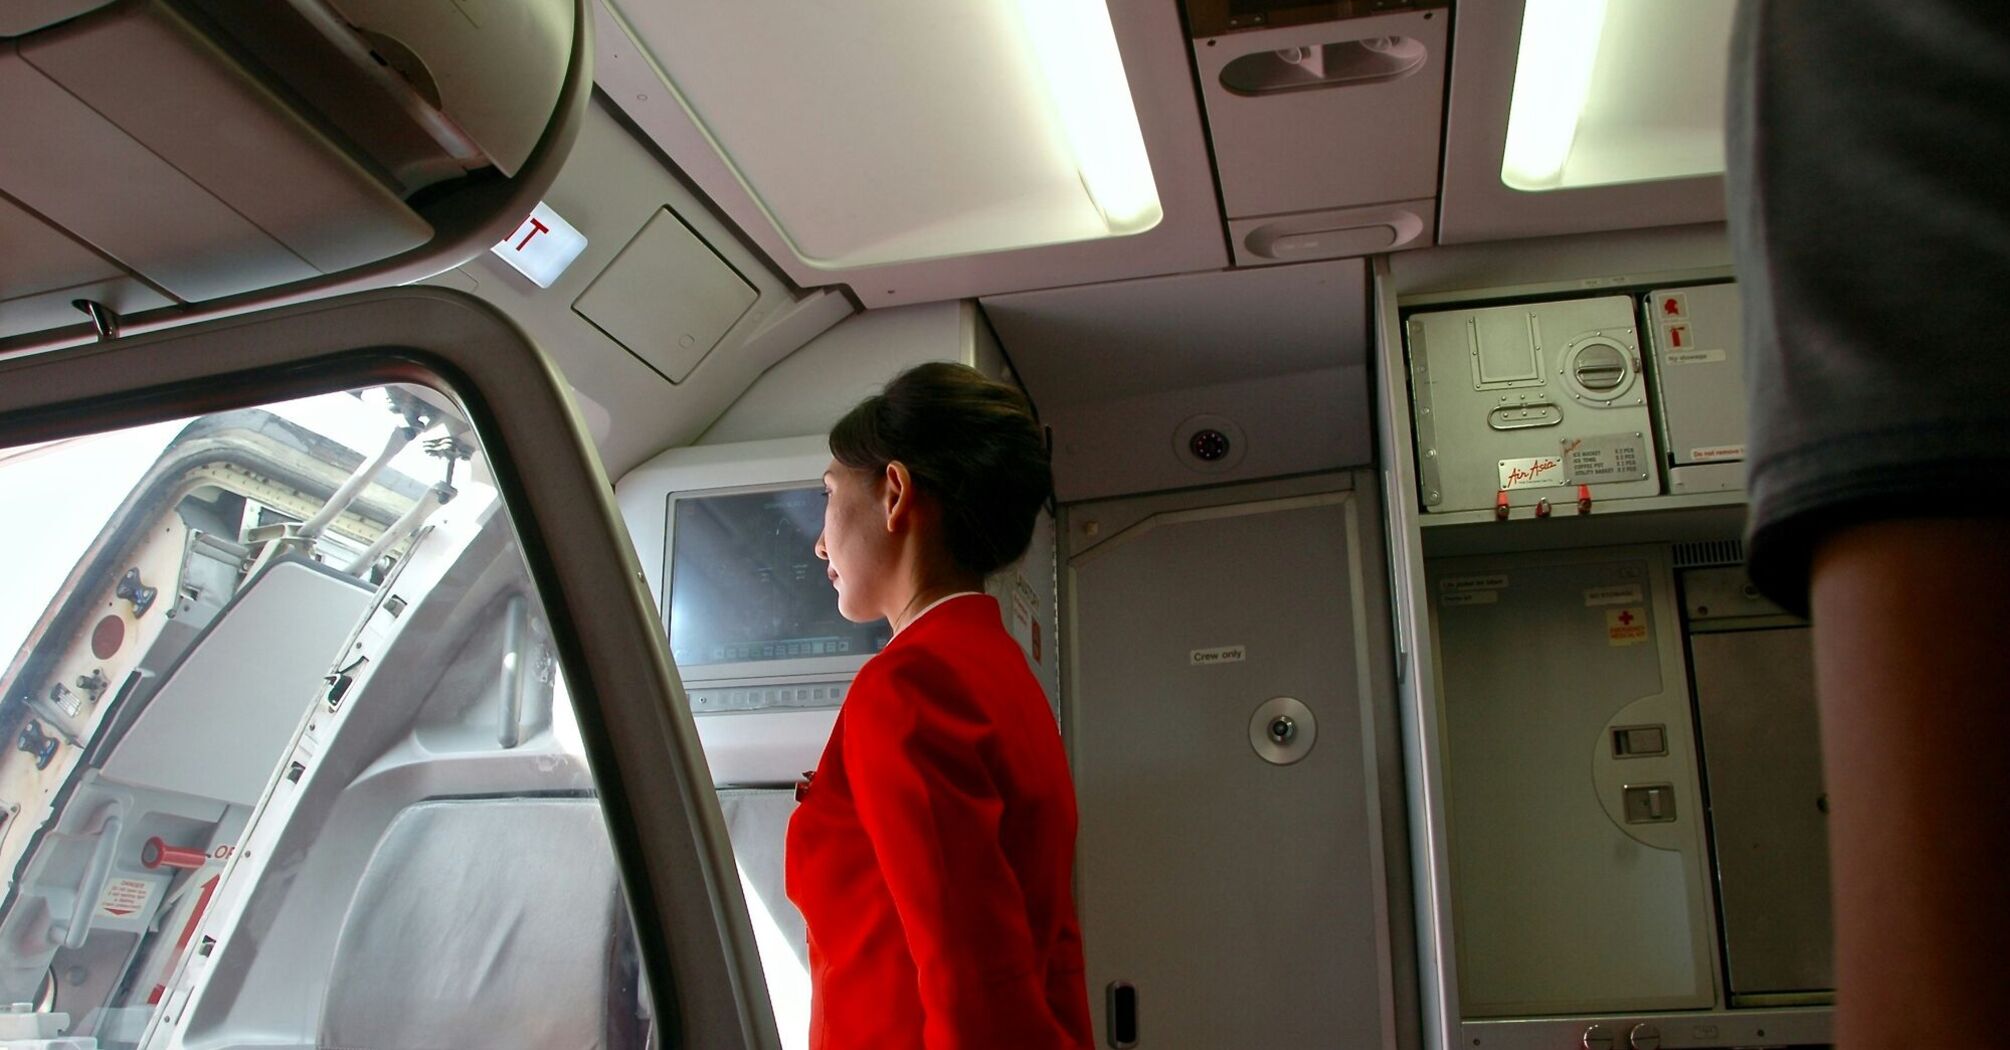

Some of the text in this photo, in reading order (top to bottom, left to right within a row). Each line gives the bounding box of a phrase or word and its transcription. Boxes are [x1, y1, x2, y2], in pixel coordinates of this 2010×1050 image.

[504, 214, 550, 252] IT
[1507, 459, 1557, 488] Air Asia
[1194, 649, 1241, 661] Crew only
